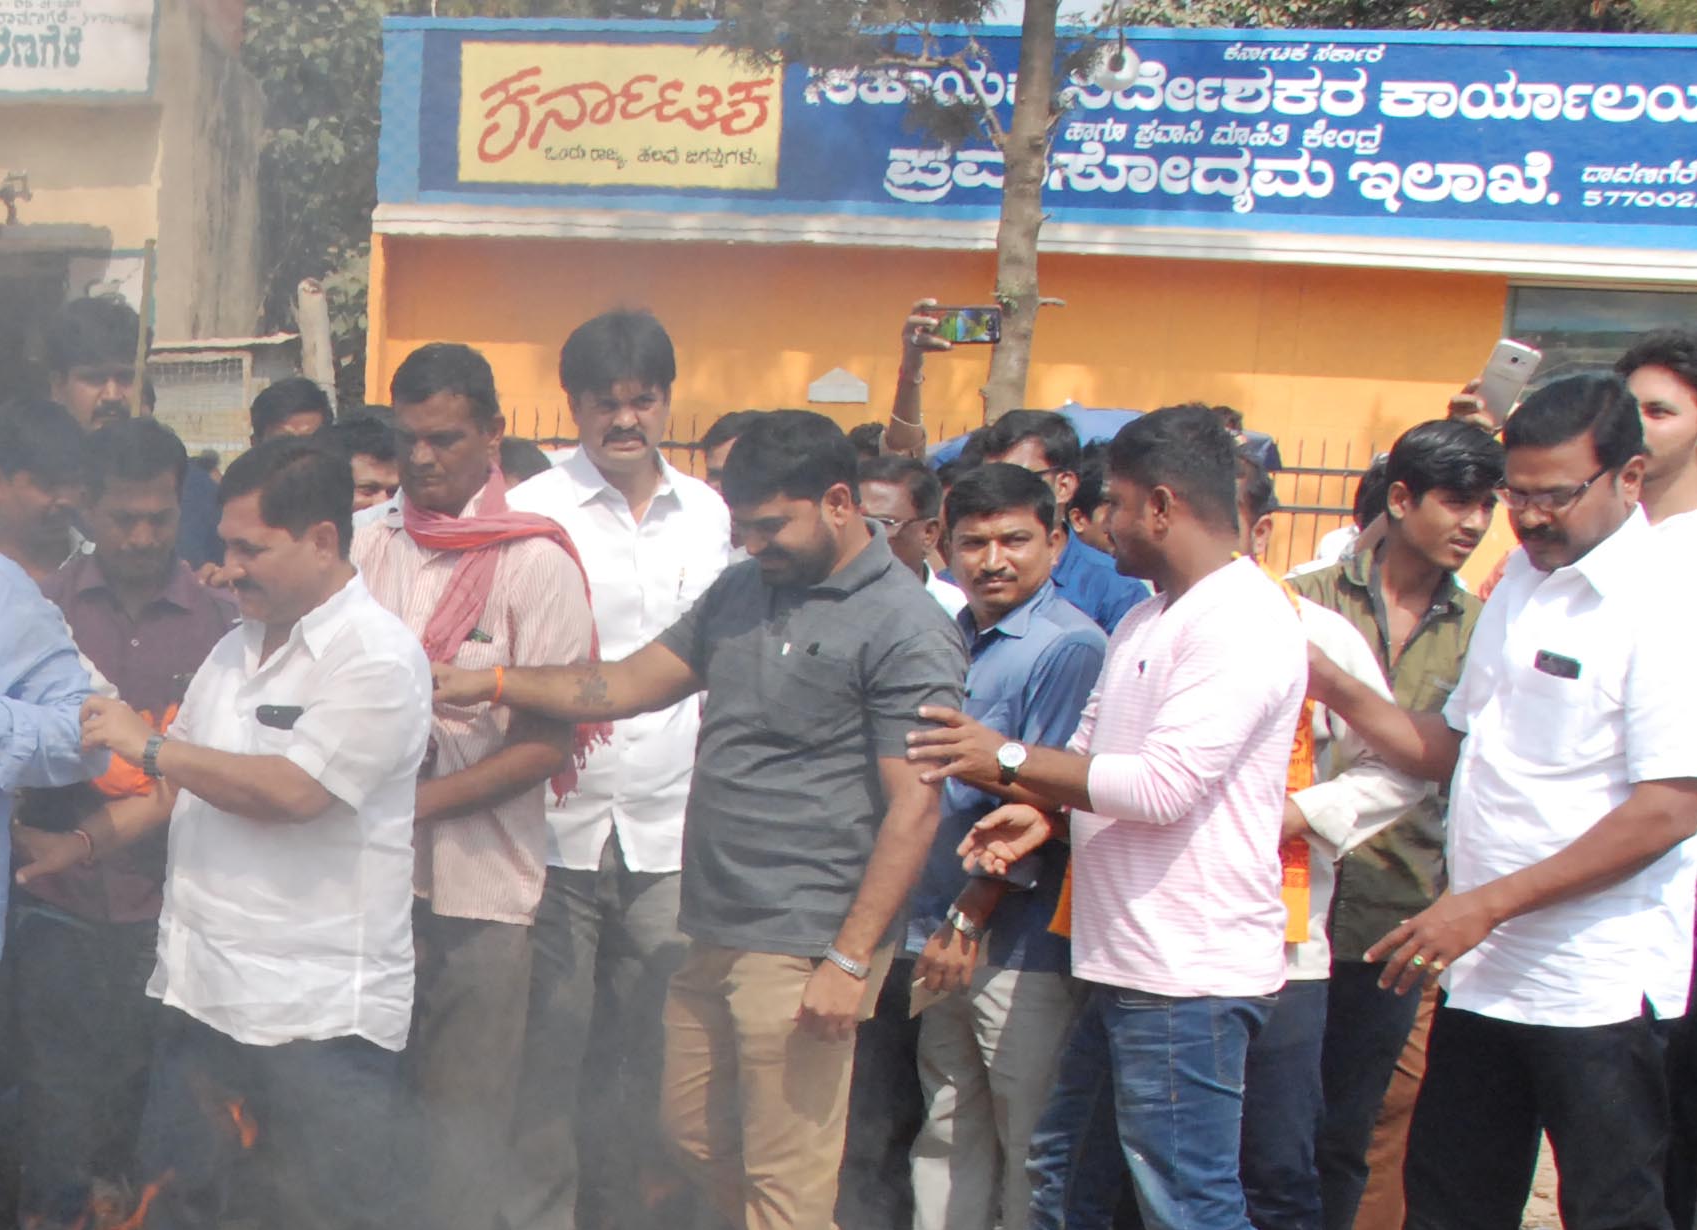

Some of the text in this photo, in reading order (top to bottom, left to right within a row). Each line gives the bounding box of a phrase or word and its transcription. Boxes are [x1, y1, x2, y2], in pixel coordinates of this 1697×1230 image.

[1222, 42, 1387, 63] ಕರ್ನಾಟಕ ಸರ್ಕಾರ
[478, 66, 775, 163] ಕರ್ನಾಟಕ
[544, 145, 587, 162] ಒಂದು
[637, 145, 680, 165] ಹಲವು
[1064, 117, 1384, 155] ಹಾಗೂ ಪ್ರವಾಸಿ ಮಾಹಿತಿ ಕೇಂದ್ರ
[882, 140, 1335, 214] ಪ್ರವಸೋದ್ಯಮ
